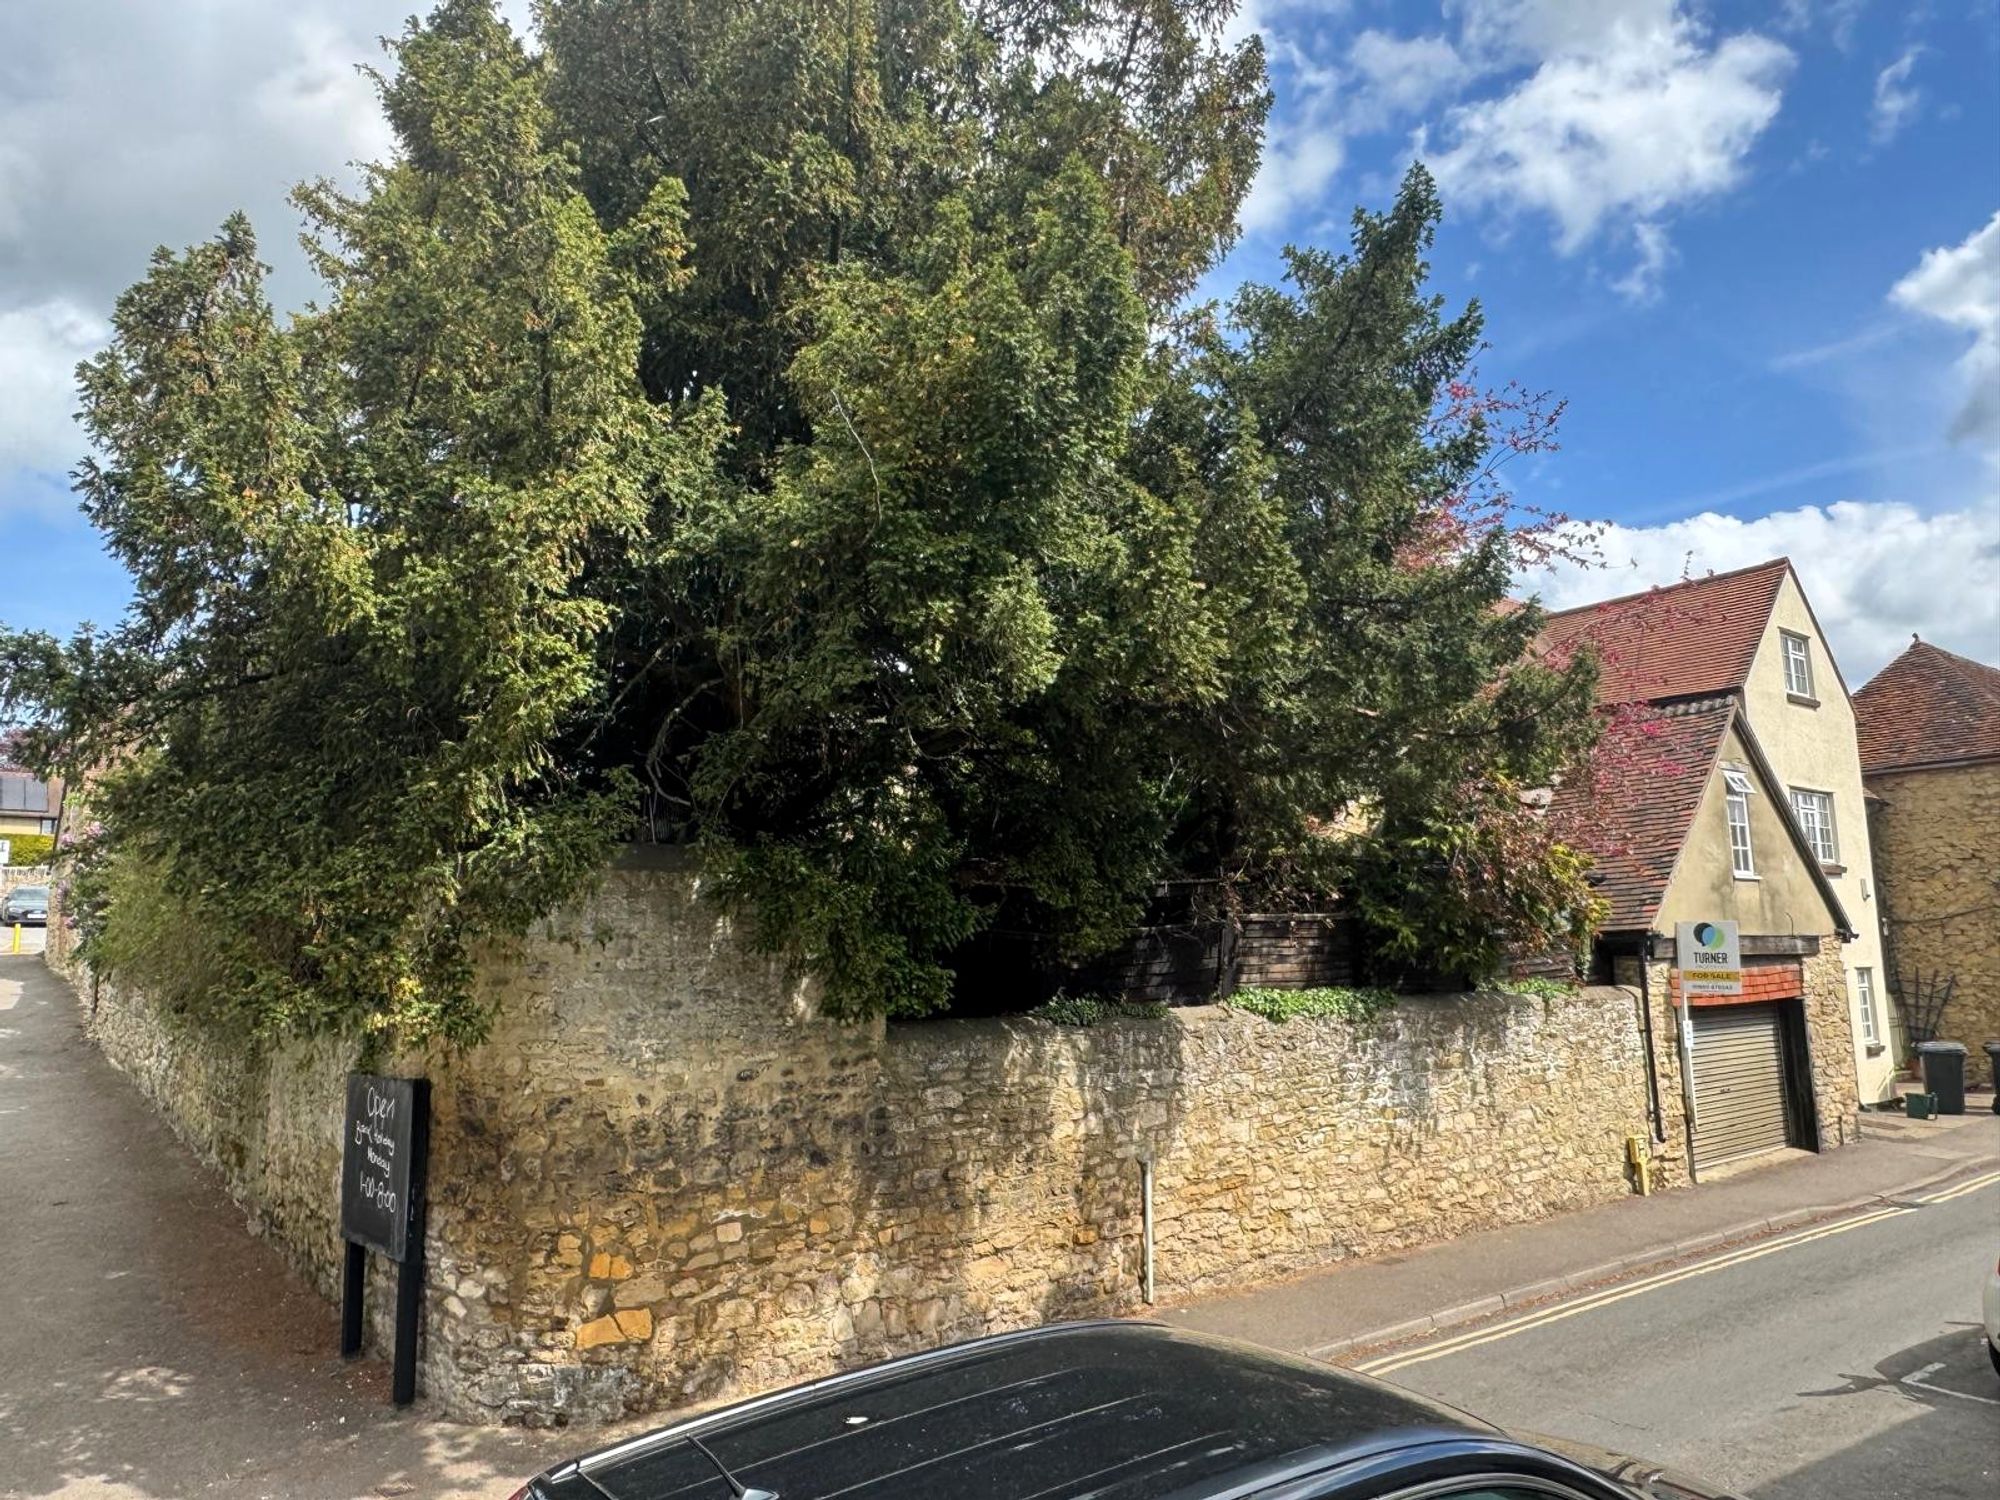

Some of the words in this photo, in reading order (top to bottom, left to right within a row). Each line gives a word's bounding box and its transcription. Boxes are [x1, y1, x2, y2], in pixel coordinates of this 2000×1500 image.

[1693, 952, 1728, 964] TURNER
[1711, 972, 1731, 980] SALE
[367, 1086, 395, 1124] Open
